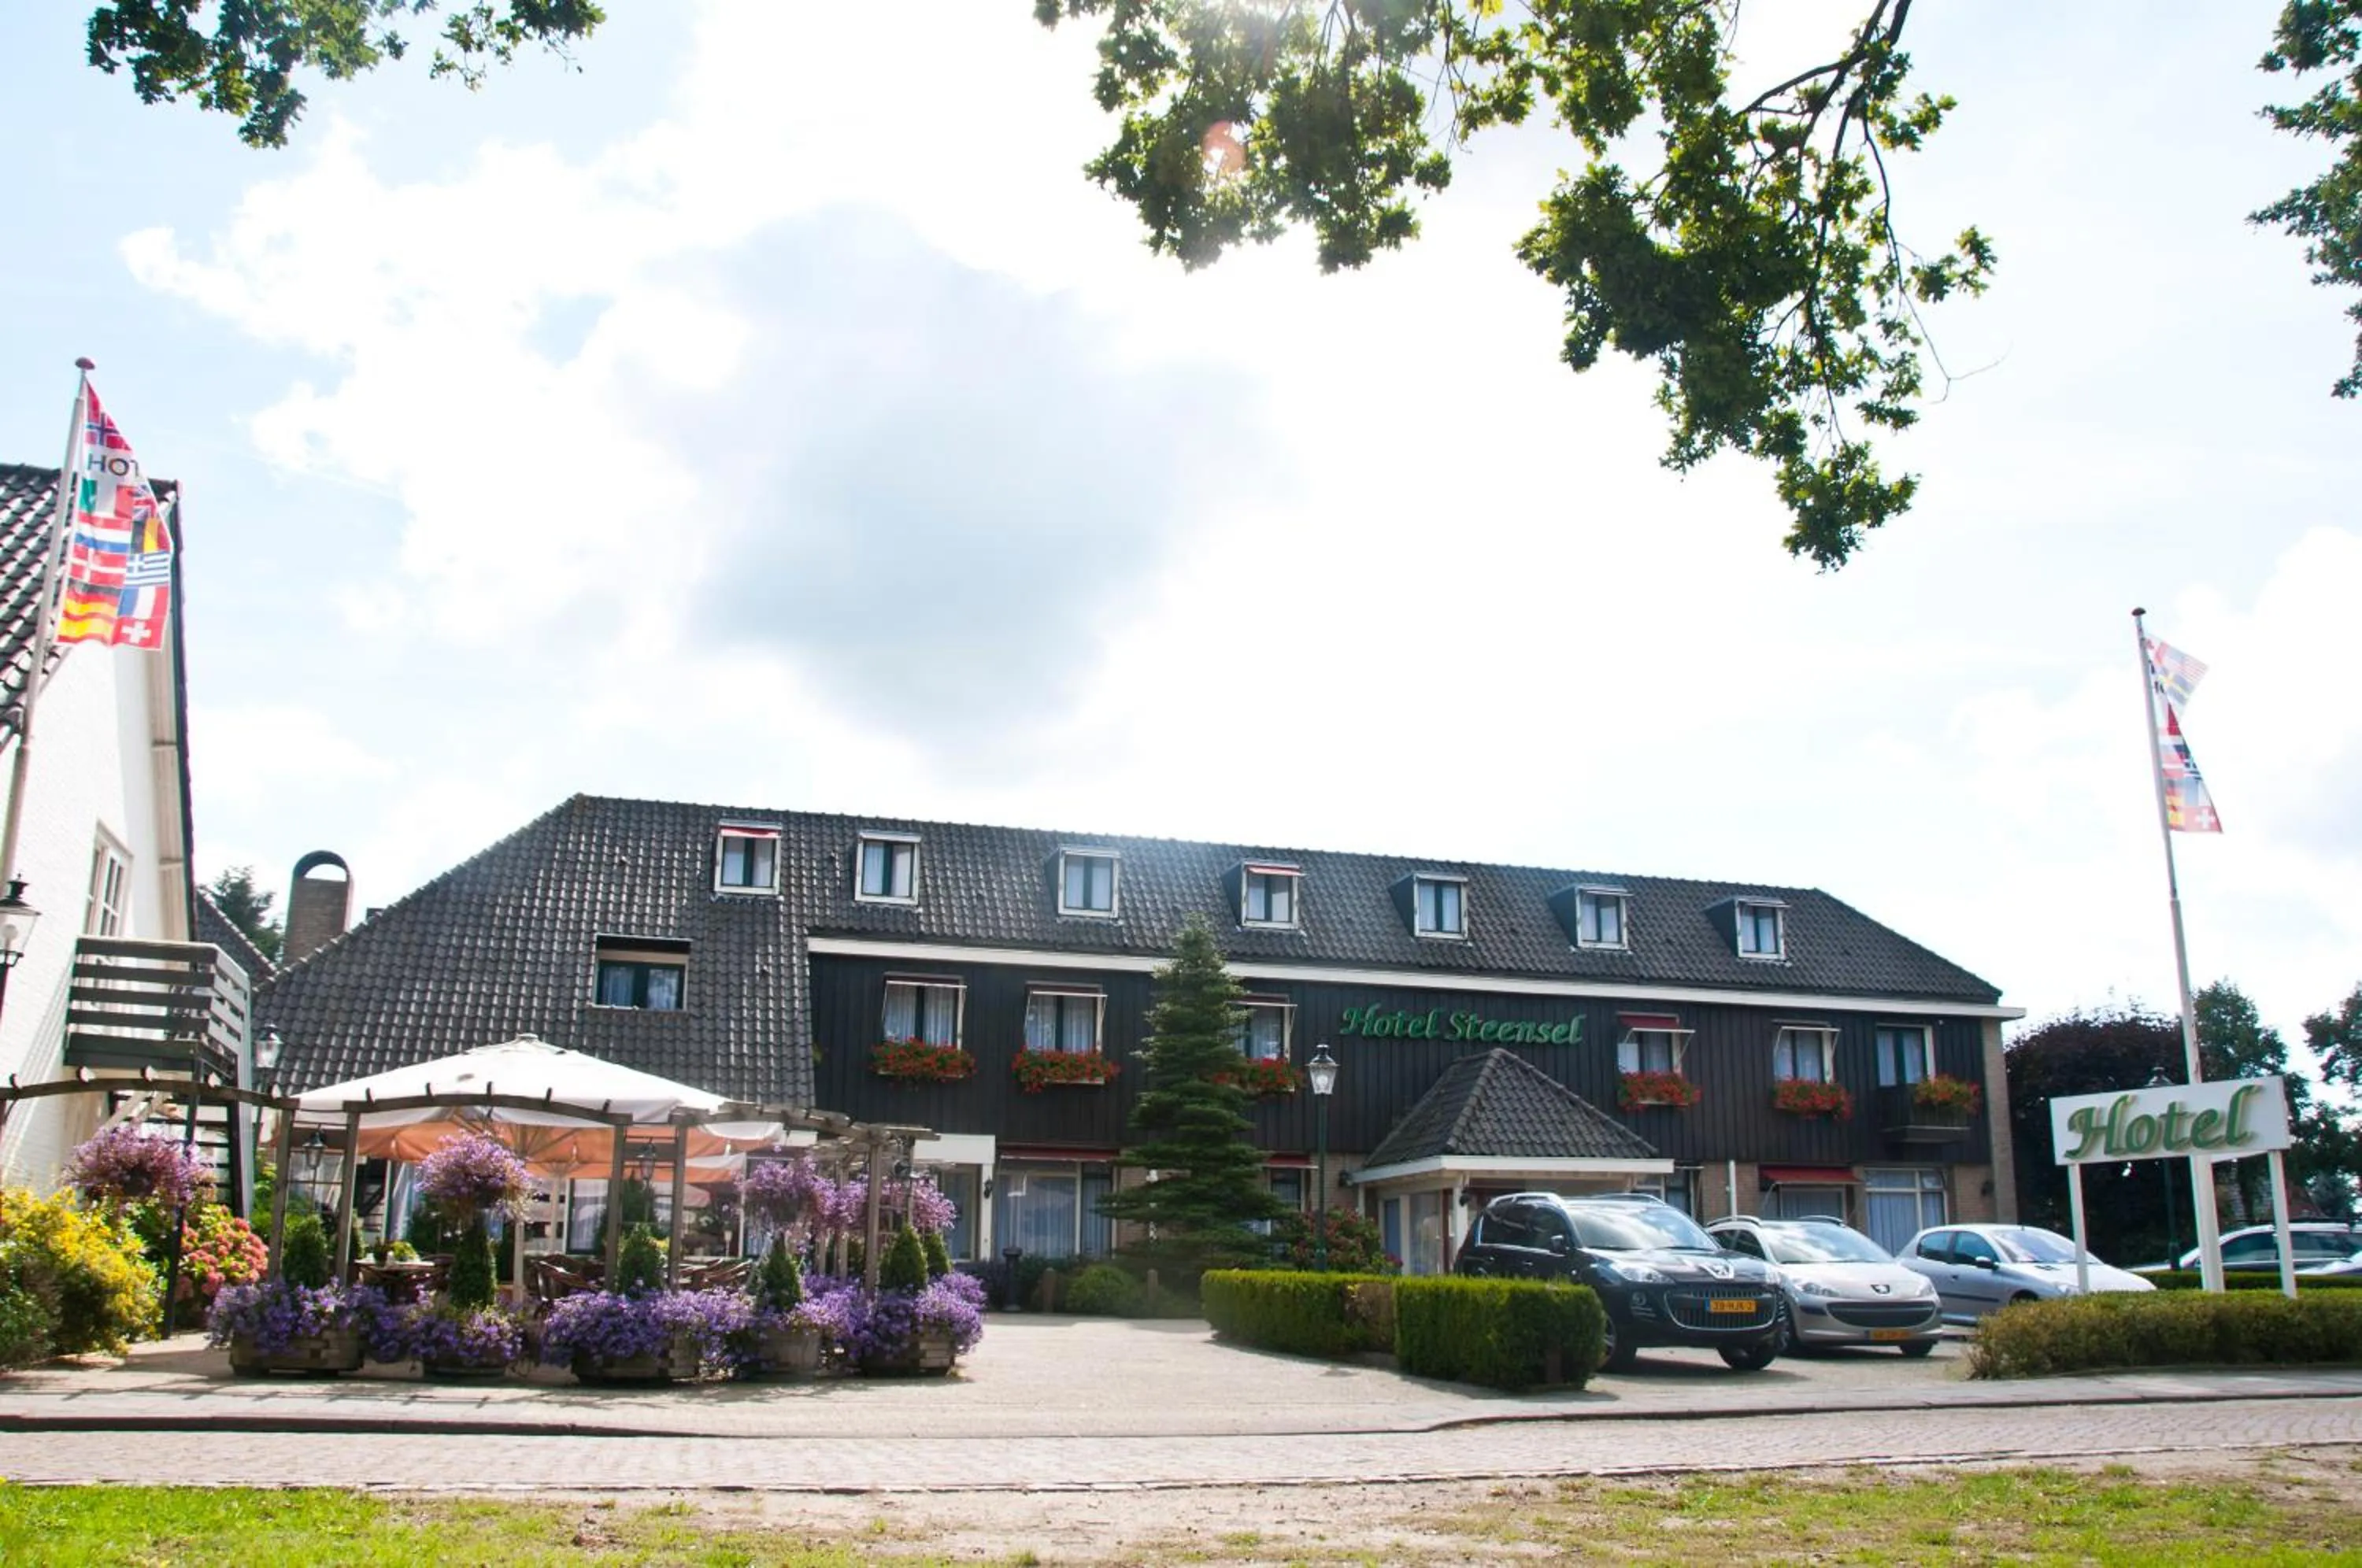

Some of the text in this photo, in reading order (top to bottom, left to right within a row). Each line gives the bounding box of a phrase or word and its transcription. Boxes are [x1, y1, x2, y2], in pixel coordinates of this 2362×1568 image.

[1340, 1003, 1587, 1045] Hotel Steensel
[2064, 1084, 2263, 1159] Hotel
